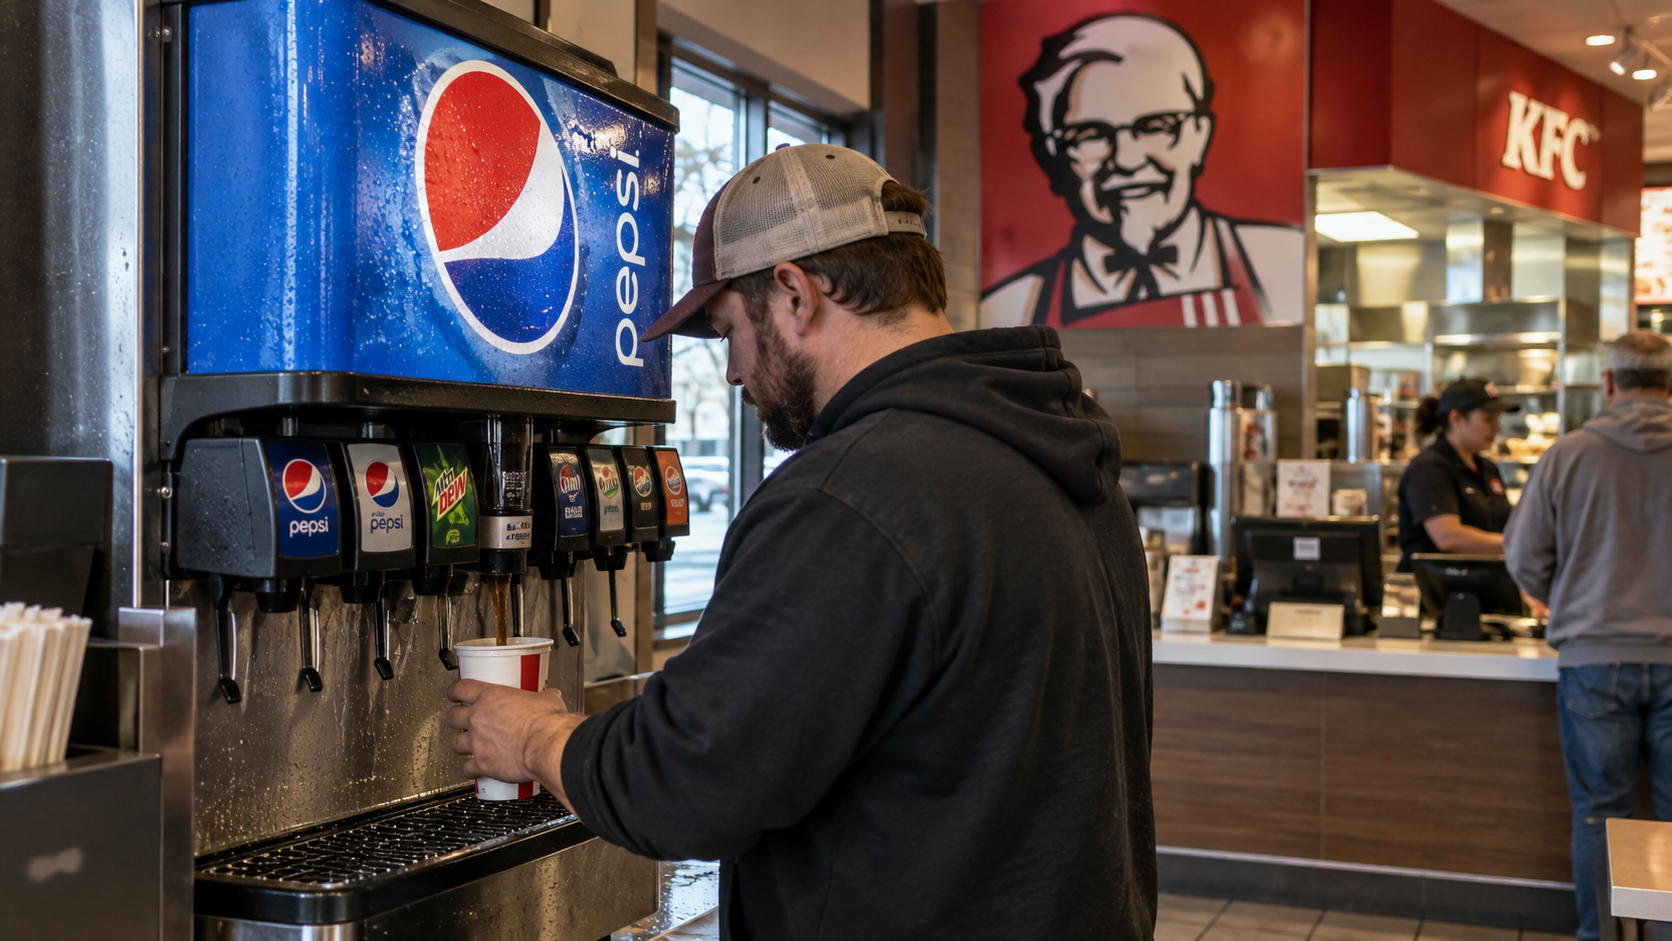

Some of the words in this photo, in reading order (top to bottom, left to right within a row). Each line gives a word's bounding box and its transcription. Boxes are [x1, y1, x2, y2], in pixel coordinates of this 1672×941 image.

[1501, 90, 1590, 191] KFC
[610, 146, 646, 367] pepsi
[289, 515, 329, 538] pepsi
[370, 513, 404, 534] pepsi
